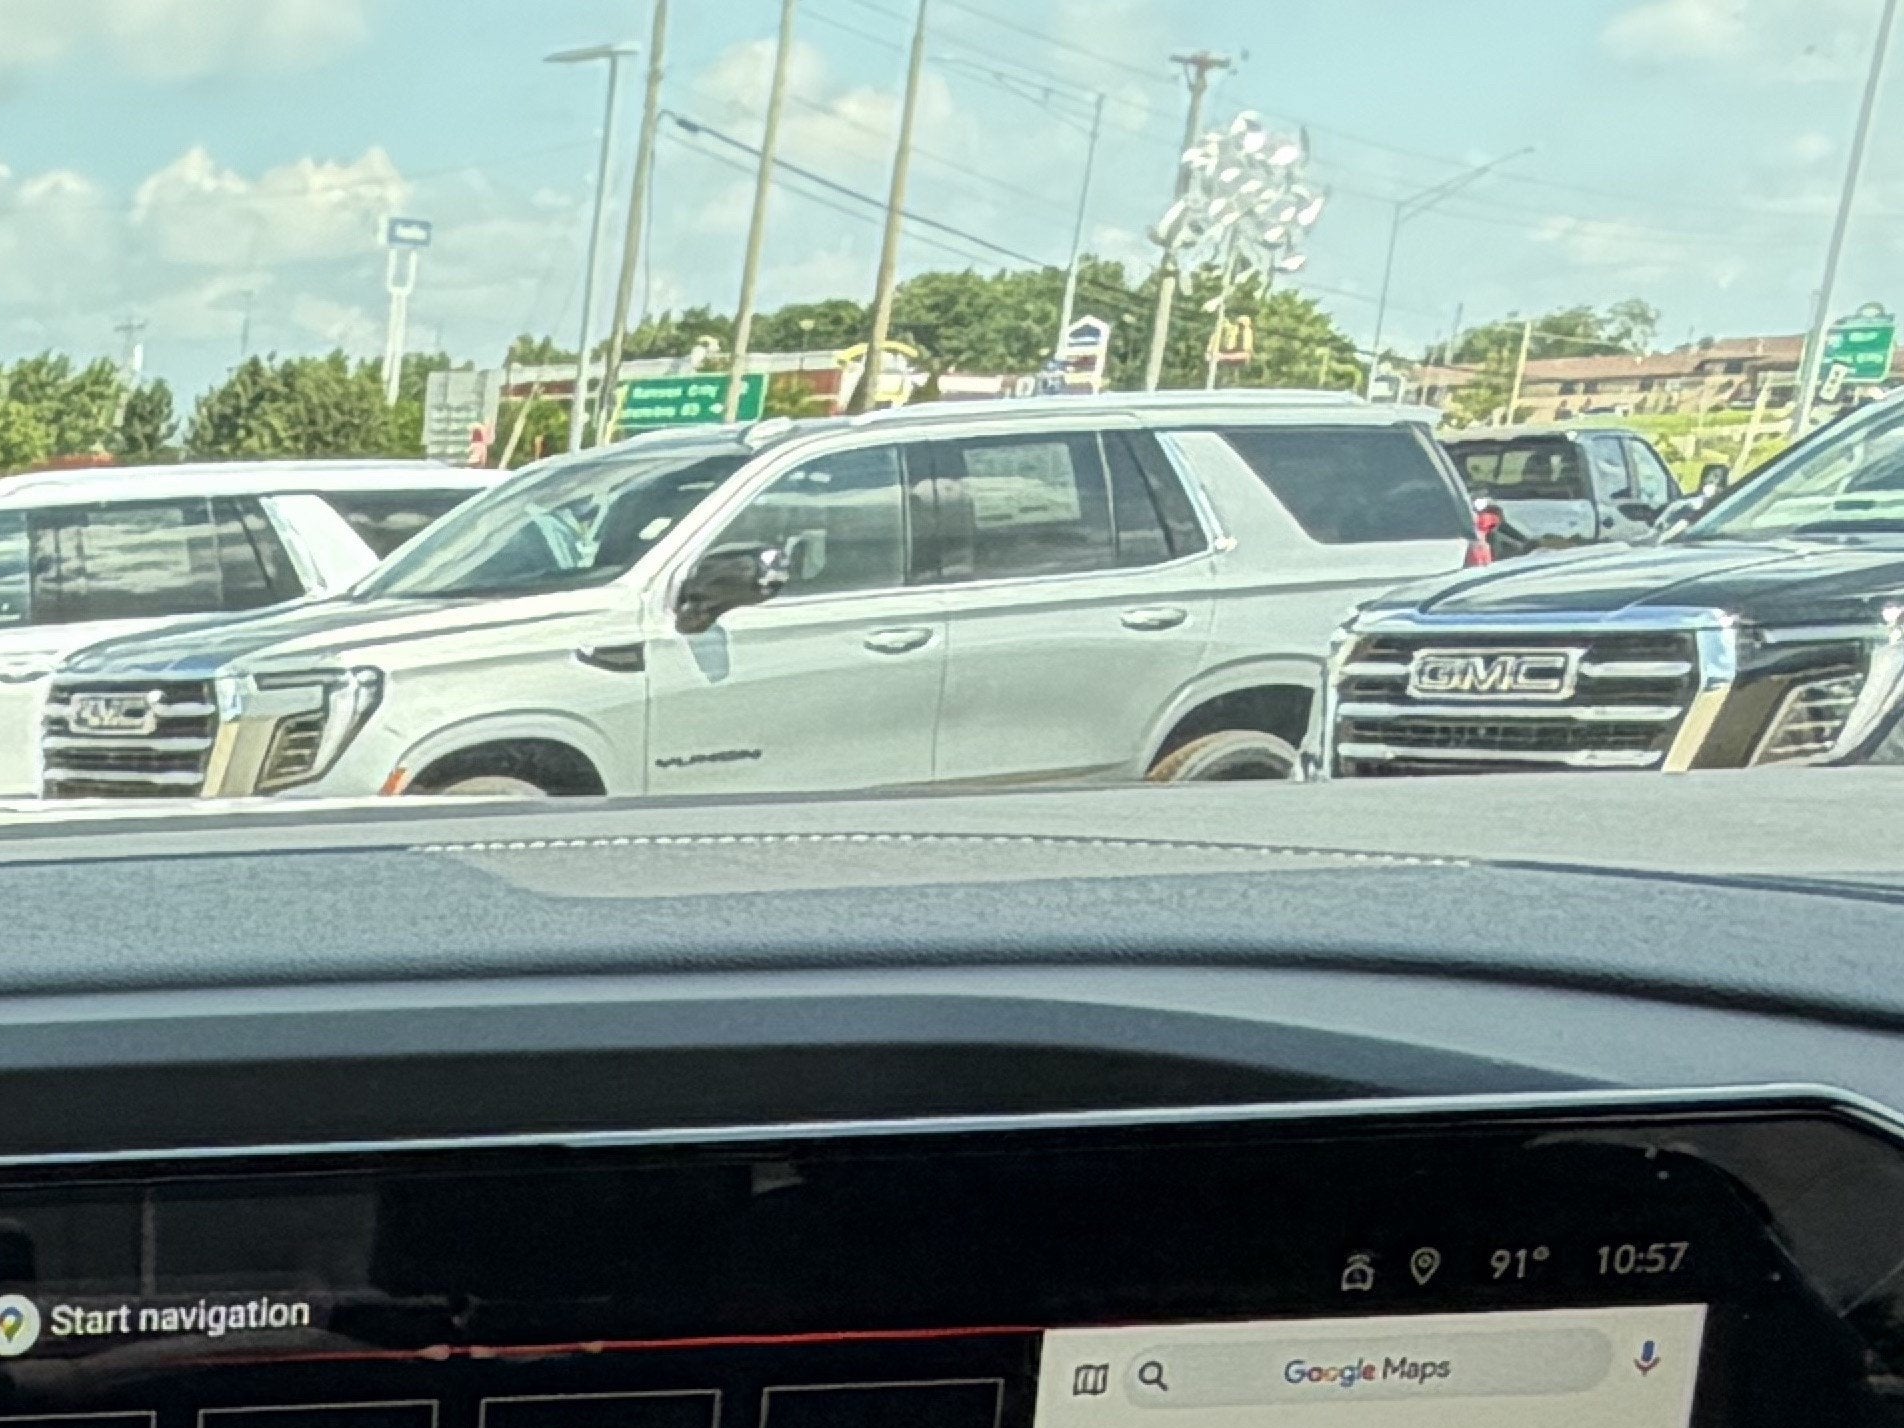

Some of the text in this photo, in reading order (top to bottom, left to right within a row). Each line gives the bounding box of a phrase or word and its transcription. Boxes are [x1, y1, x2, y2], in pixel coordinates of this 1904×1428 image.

[1417, 655, 1565, 690] GMC
[1599, 1241, 1689, 1273] 10:57
[51, 1297, 309, 1337] Start navigation
[1284, 1357, 1451, 1387] Google Maps
